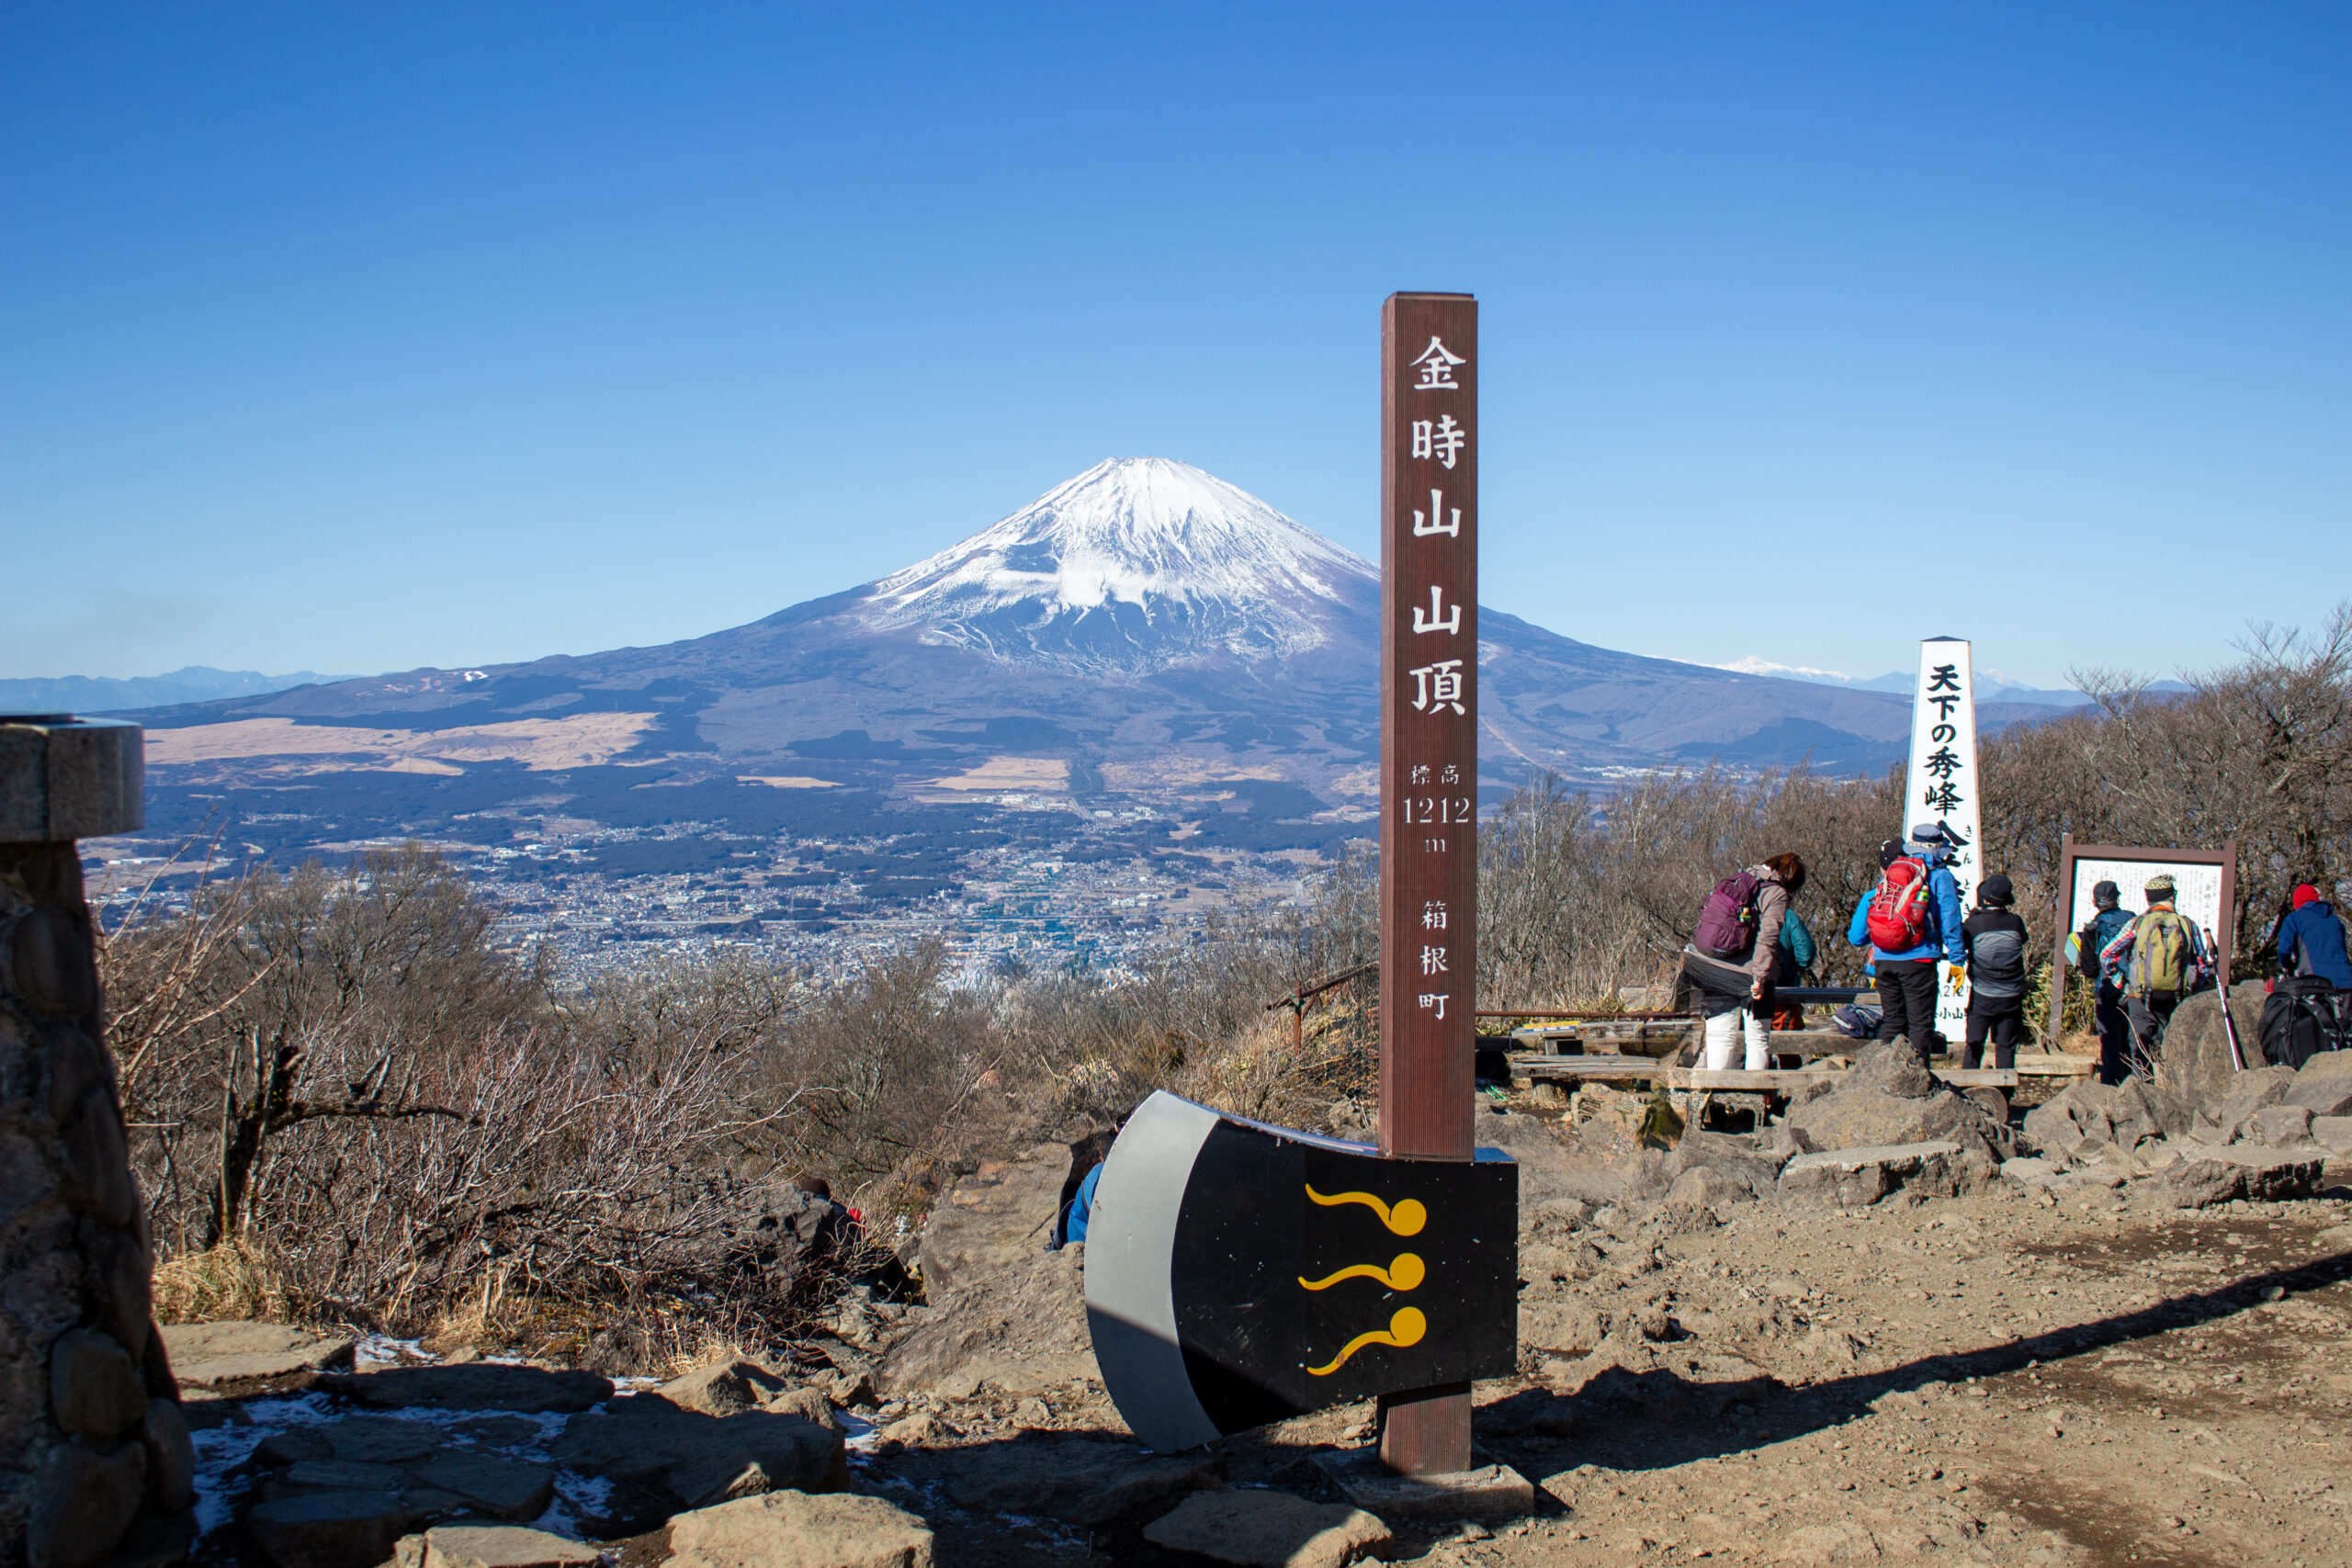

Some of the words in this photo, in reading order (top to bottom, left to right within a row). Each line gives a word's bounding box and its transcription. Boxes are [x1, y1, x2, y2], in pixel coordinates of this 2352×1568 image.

[1409, 335, 1467, 538] 金時山
[1408, 585, 1466, 716] 山頂
[1410, 763, 1460, 785] 標高
[1923, 663, 1965, 817] 天下の秀峰
[1403, 796, 1470, 824] 1212
[1425, 837, 1447, 853] m
[1418, 899, 1450, 1021] 箱根町
